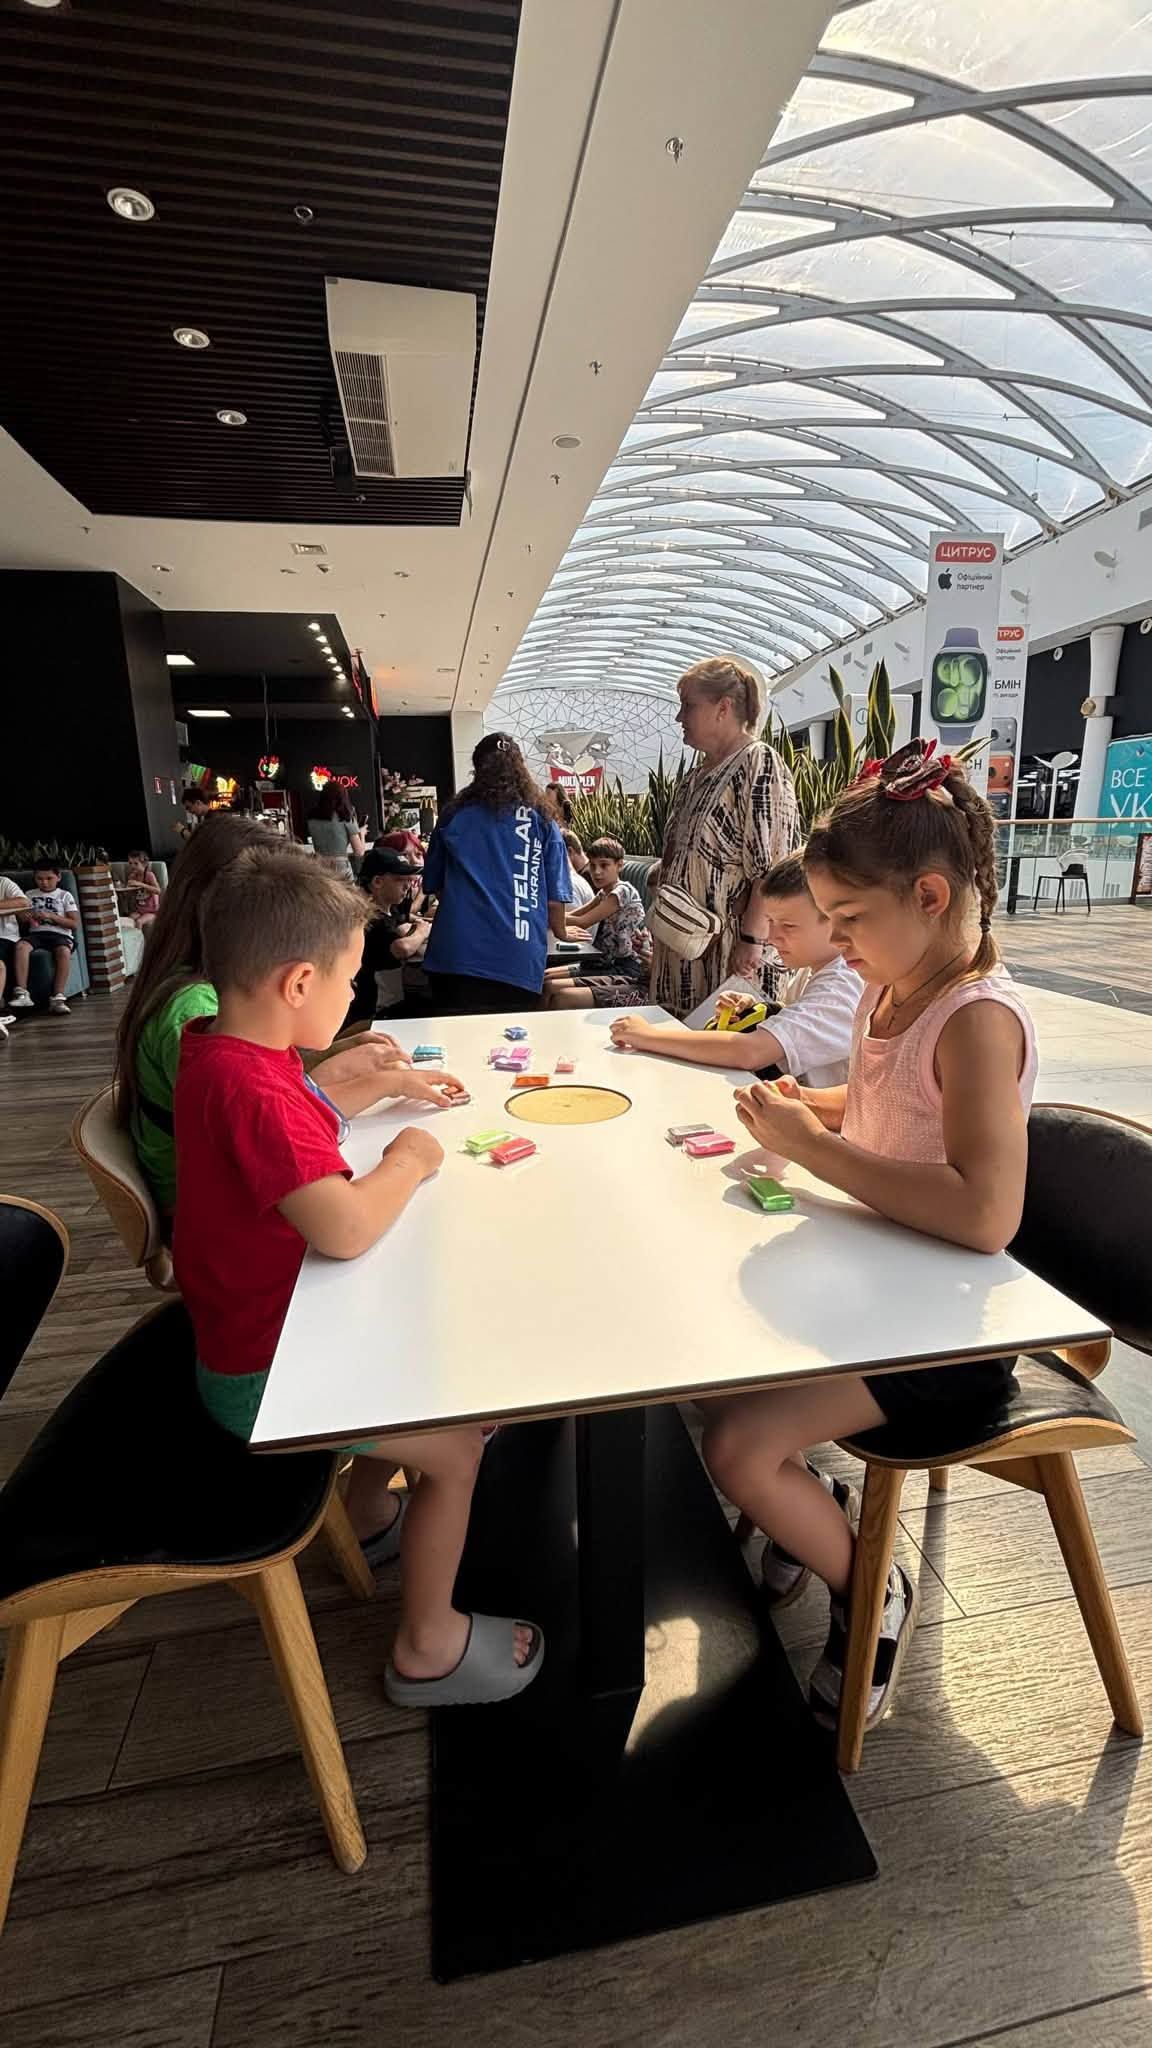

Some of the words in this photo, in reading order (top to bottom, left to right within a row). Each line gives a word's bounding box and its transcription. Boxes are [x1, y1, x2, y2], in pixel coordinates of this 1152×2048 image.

[941, 546, 992, 558] ЦИТРУС
[558, 776, 596, 787] MULTPLEX
[1111, 768, 1147, 788] ВСЕ
[513, 805, 532, 941] STELLAR
[530, 838, 543, 909] UKRAINE
